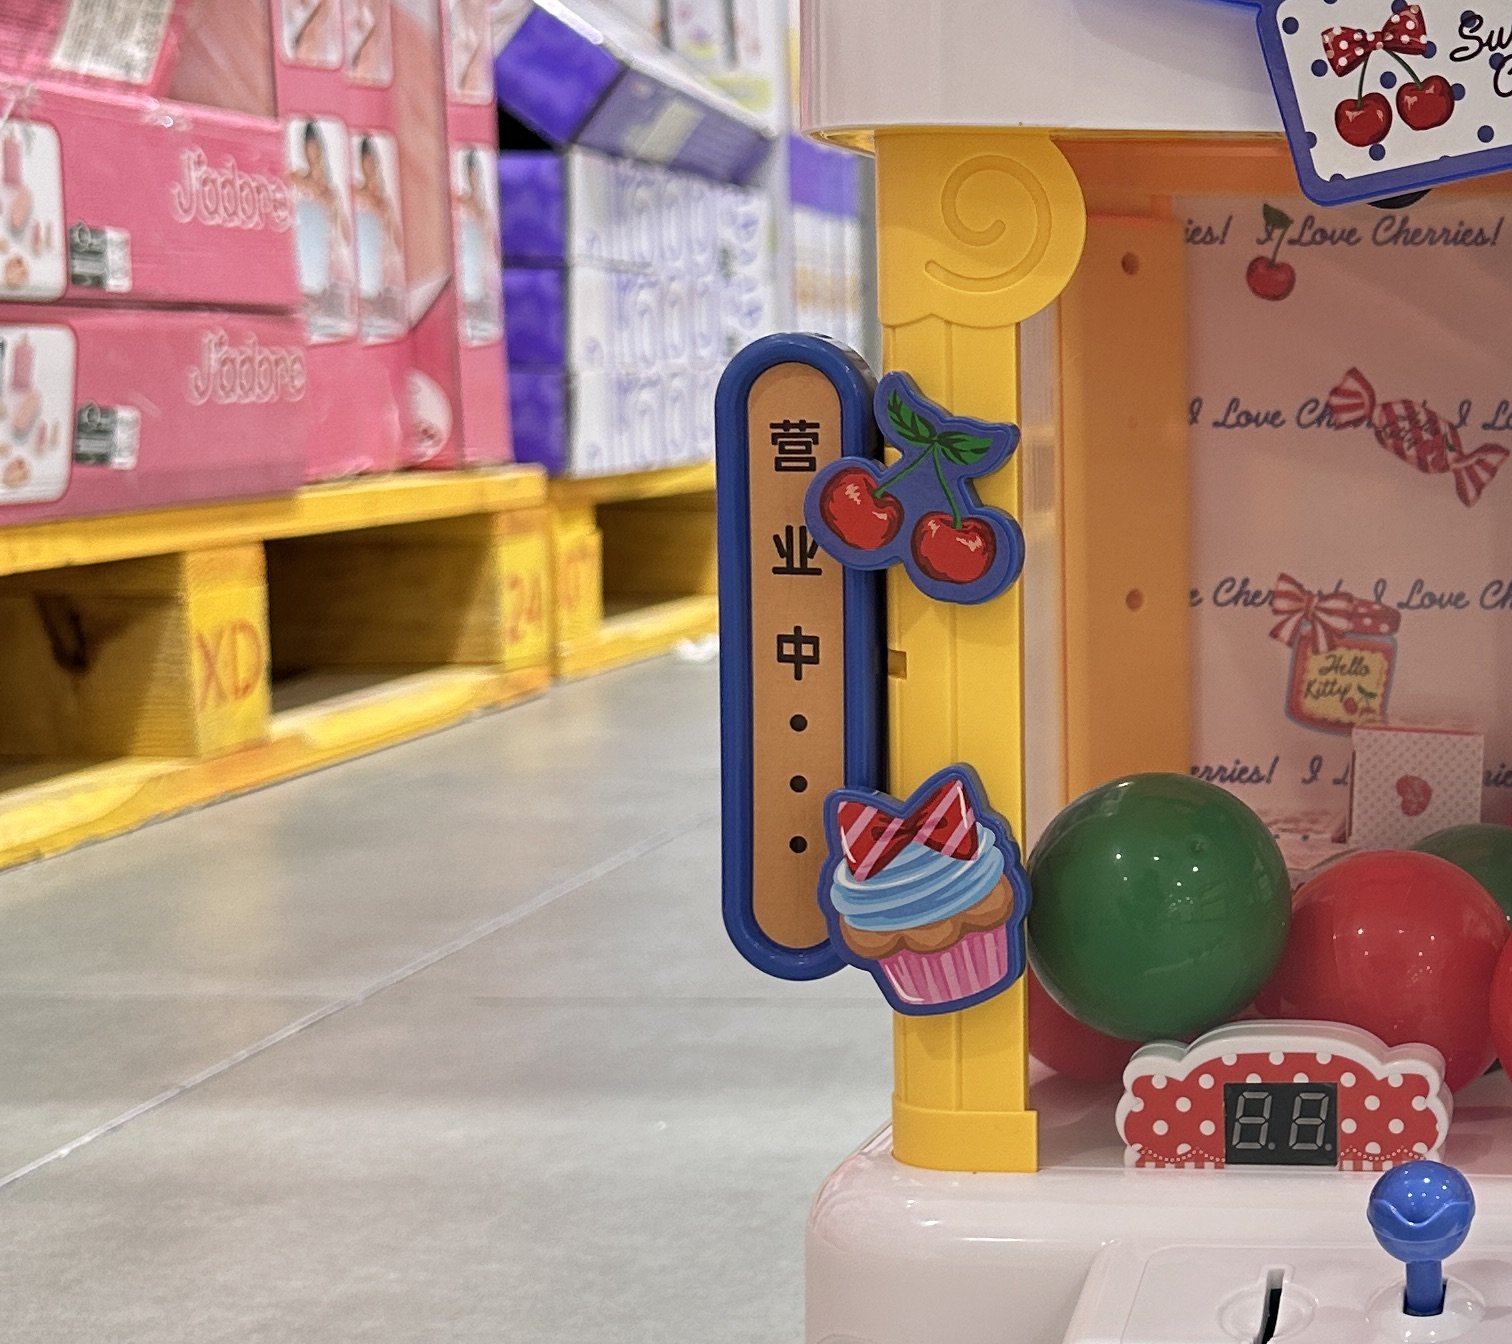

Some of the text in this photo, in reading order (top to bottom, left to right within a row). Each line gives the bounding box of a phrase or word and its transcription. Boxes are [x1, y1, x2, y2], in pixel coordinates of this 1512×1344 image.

[1287, 216, 1361, 247] Love
[1372, 215, 1504, 247] Cherries!
[1212, 398, 1286, 428] Love
[1398, 579, 1470, 610] Love
[1319, 654, 1371, 678] Hello
[1304, 677, 1353, 702] Kitty
